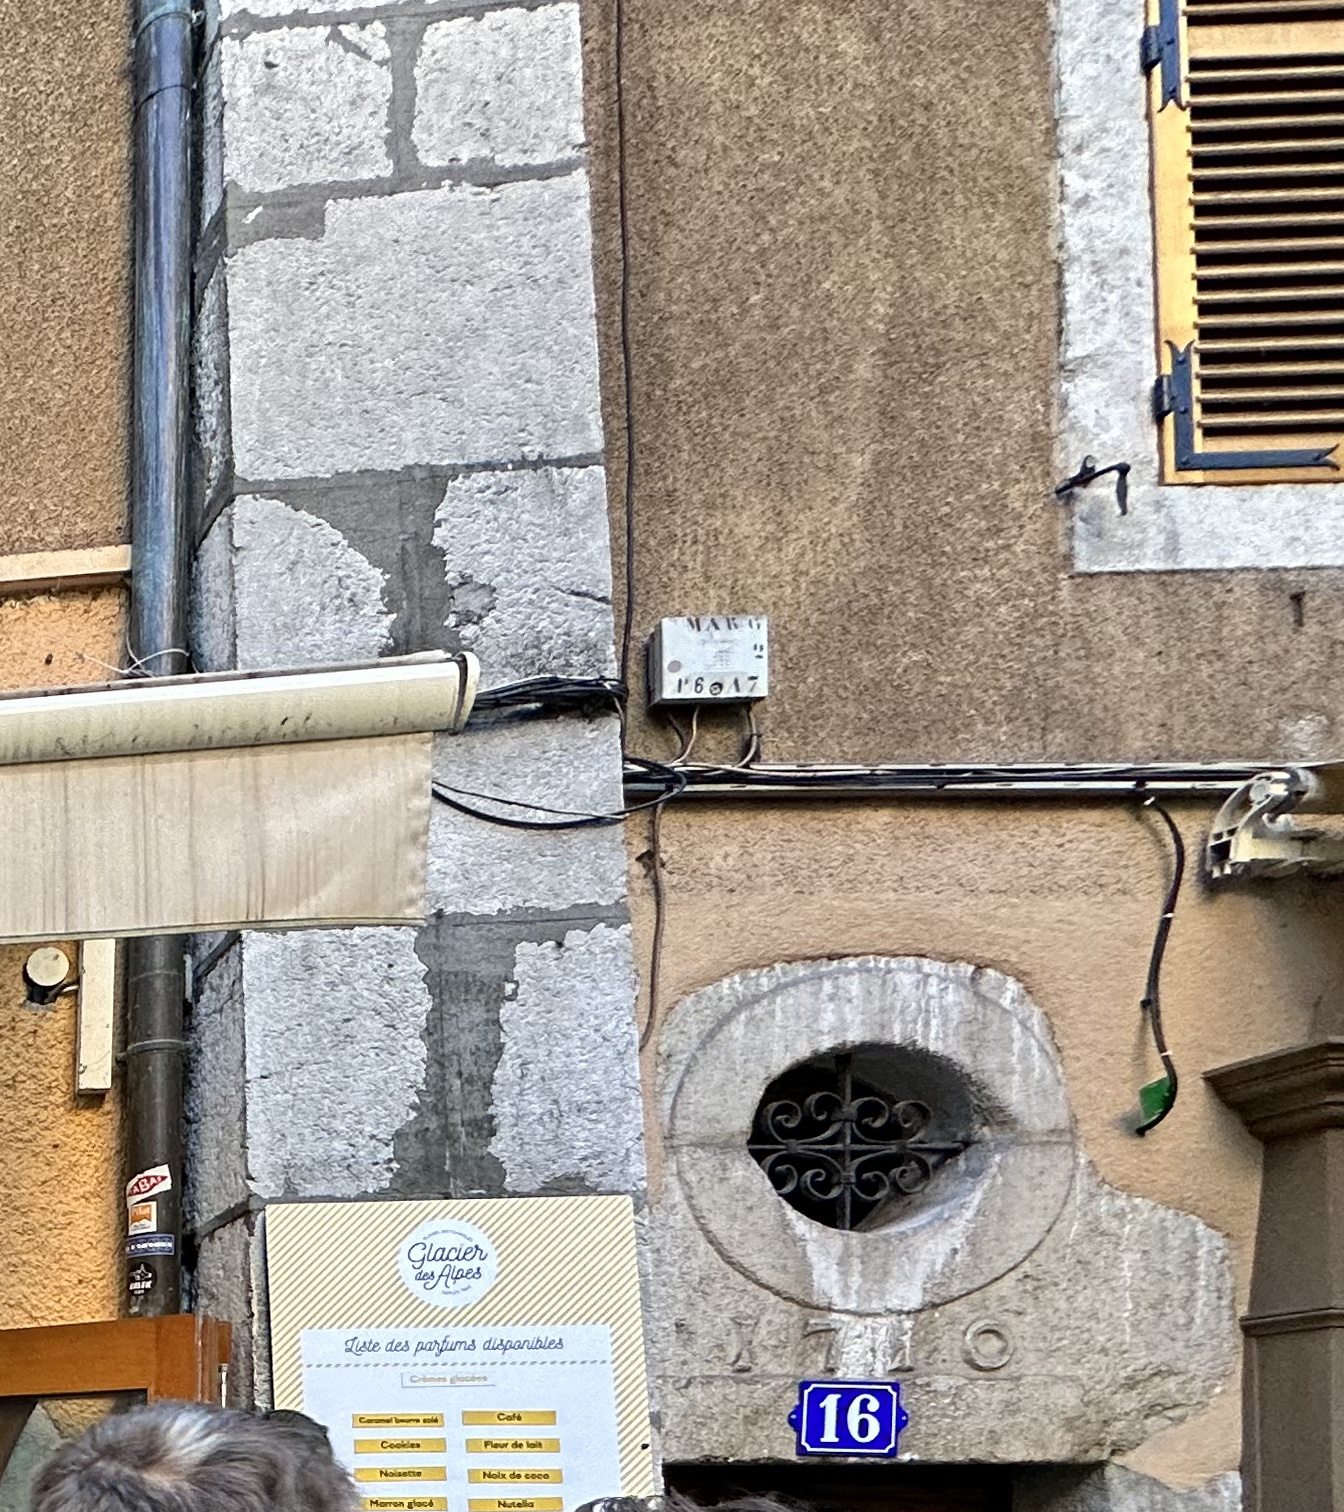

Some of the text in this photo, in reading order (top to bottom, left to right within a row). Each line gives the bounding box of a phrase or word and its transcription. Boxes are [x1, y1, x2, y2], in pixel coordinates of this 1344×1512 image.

[407, 1242, 489, 1270] Glacier
[414, 1270, 436, 1281] des
[423, 1263, 482, 1290] Alpes
[344, 1335, 564, 1357] Liste des parfums disponibles
[410, 1374, 448, 1384] Crèmes
[358, 1416, 439, 1424] Caramel beurre salé
[496, 1412, 523, 1422] Café
[818, 1393, 882, 1443] 16
[380, 1440, 421, 1450] Cookies
[483, 1440, 543, 1450] Fleur de lait
[379, 1469, 422, 1478] Noisette
[482, 1471, 507, 1480] Noix
[509, 1471, 522, 1480] de
[370, 1499, 434, 1510] Marron glacé
[497, 1500, 535, 1509] Nutella
